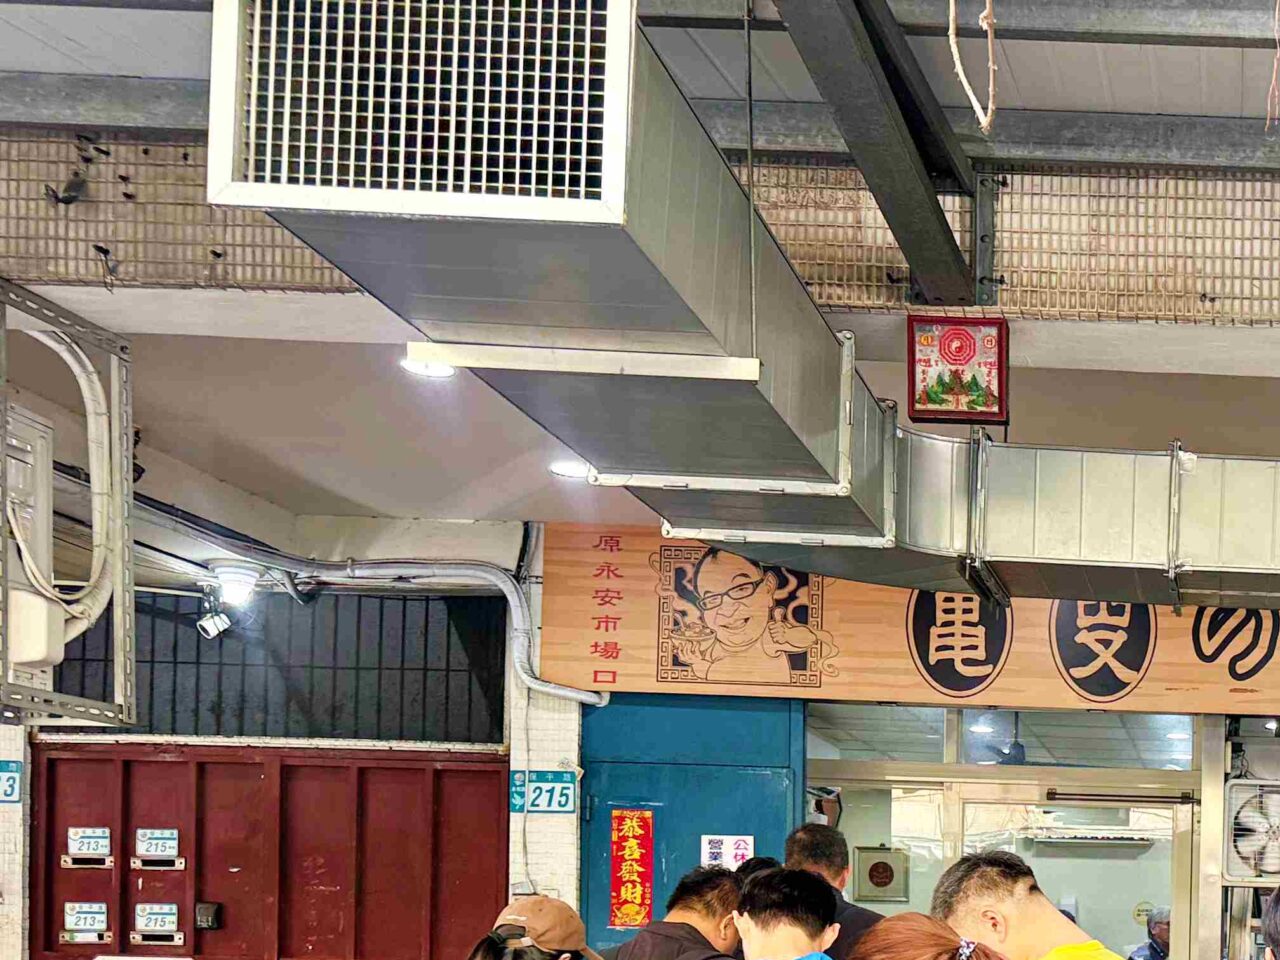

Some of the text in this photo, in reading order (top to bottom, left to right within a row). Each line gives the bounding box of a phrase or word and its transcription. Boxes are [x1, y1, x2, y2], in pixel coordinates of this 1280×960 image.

[590, 535, 625, 684] 原永安市場口
[530, 786, 571, 808] 215
[77, 840, 100, 851] 213
[145, 842, 168, 853] 215
[617, 817, 646, 904] 恭喜發財
[74, 916, 97, 927] 213
[144, 917, 167, 928] 215
